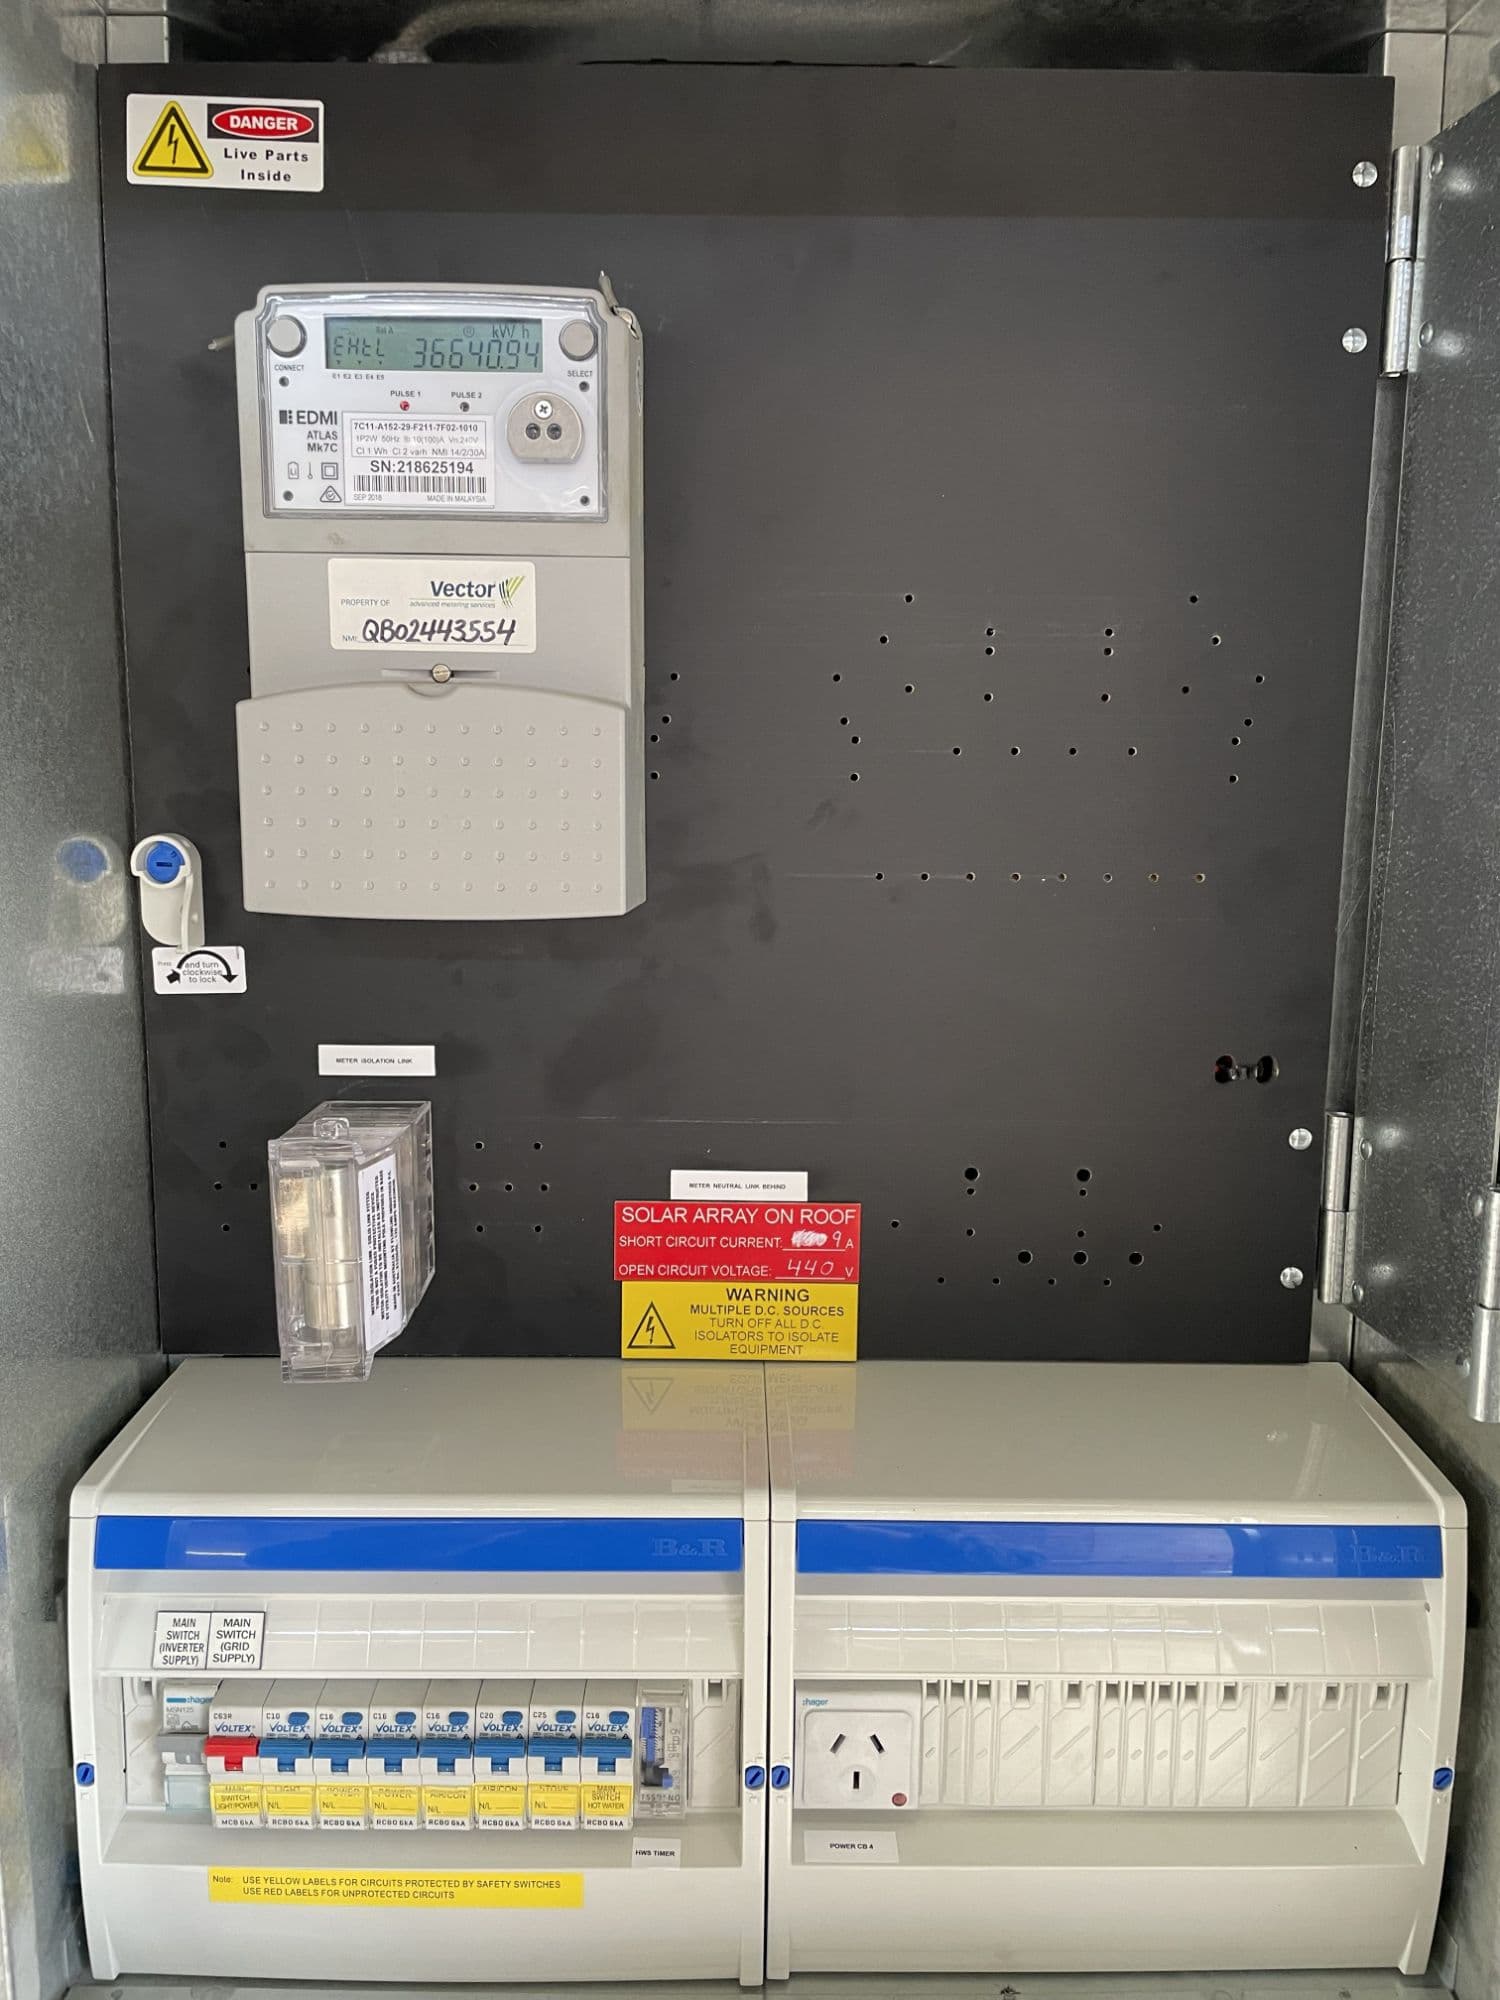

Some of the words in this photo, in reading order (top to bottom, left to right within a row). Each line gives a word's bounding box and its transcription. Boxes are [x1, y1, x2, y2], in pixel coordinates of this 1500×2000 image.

[229, 115, 298, 131] DANGER
[224, 148, 257, 160] Live
[266, 150, 309, 162] Parts
[241, 169, 291, 182] Inside
[413, 338, 540, 369] 36640.94
[274, 364, 304, 372] CONNECT
[568, 370, 592, 378] SELECT
[296, 410, 338, 425] EDMI
[307, 430, 338, 440] ATLAS
[307, 442, 338, 452] Mk7C
[370, 460, 473, 474] SN:218625194
[430, 581, 496, 598] Vector
[622, 1207, 687, 1223] SOLAR
[693, 1208, 759, 1224] ARRAY
[764, 1208, 793, 1225] ON
[801, 1209, 856, 1225] ROOF
[619, 1236, 663, 1247] SHORT
[668, 1236, 716, 1248] CIRCUIT
[832, 1231, 841, 1248] 9
[845, 1239, 854, 1249] A
[618, 1264, 654, 1276] OPEN
[658, 1265, 708, 1276] CIRCUIT
[711, 1266, 772, 1277] VOLTAGE:
[787, 1260, 834, 1276] 440
[845, 1267, 853, 1277] V
[726, 1288, 810, 1302] WARNING
[690, 1305, 750, 1316] MULTIPLE
[755, 1306, 779, 1316] D.C.
[784, 1306, 844, 1317] SOURCES
[710, 1318, 743, 1328] TURN
[748, 1319, 771, 1329] OFF
[775, 1319, 798, 1329] ALL
[695, 1331, 763, 1341] ISOLATORS
[769, 1331, 785, 1342] TO
[788, 1332, 839, 1342] ISOLATE
[730, 1344, 803, 1355] EQUIPMENT
[173, 1618, 196, 1627] MAIN
[224, 1619, 251, 1627] MAIN
[167, 1630, 200, 1640] SWITCH
[216, 1630, 256, 1639] SWITCH
[160, 1643, 204, 1654] (INVERTER
[220, 1642, 250, 1652] (GRID
[162, 1655, 199, 1666] SUPPLY)
[213, 1654, 255, 1664] SUPPLY)
[215, 1722, 250, 1732] VOLTEX
[270, 1722, 306, 1733] VOLTEX
[322, 1722, 359, 1733] VOLTEX
[376, 1722, 412, 1733] VOLTEX
[428, 1722, 464, 1732] VOLTEX
[483, 1721, 519, 1732] VOLTEX
[536, 1721, 572, 1732] VOLTEX
[588, 1721, 625, 1732] VOLTEX
[322, 1801, 335, 1809] N/L
[479, 1802, 491, 1810] N/L
[535, 1801, 548, 1809] N/L
[635, 1849, 652, 1857] HWS
[242, 1876, 261, 1885] USE
[263, 1877, 300, 1885] YELLOW
[302, 1878, 337, 1886] LABELS
[360, 1879, 402, 1887] CIRCUITS
[405, 1880, 460, 1888] PROTECTED
[462, 1880, 474, 1888] BY
[476, 1880, 511, 1888] SAFETY
[514, 1881, 560, 1889] SWITCHES
[264, 1888, 282, 1896] RED
[321, 1889, 340, 1897] FOR
[342, 1890, 410, 1898] UNPROTECTED
[412, 1891, 455, 1899] CIRCUITS
